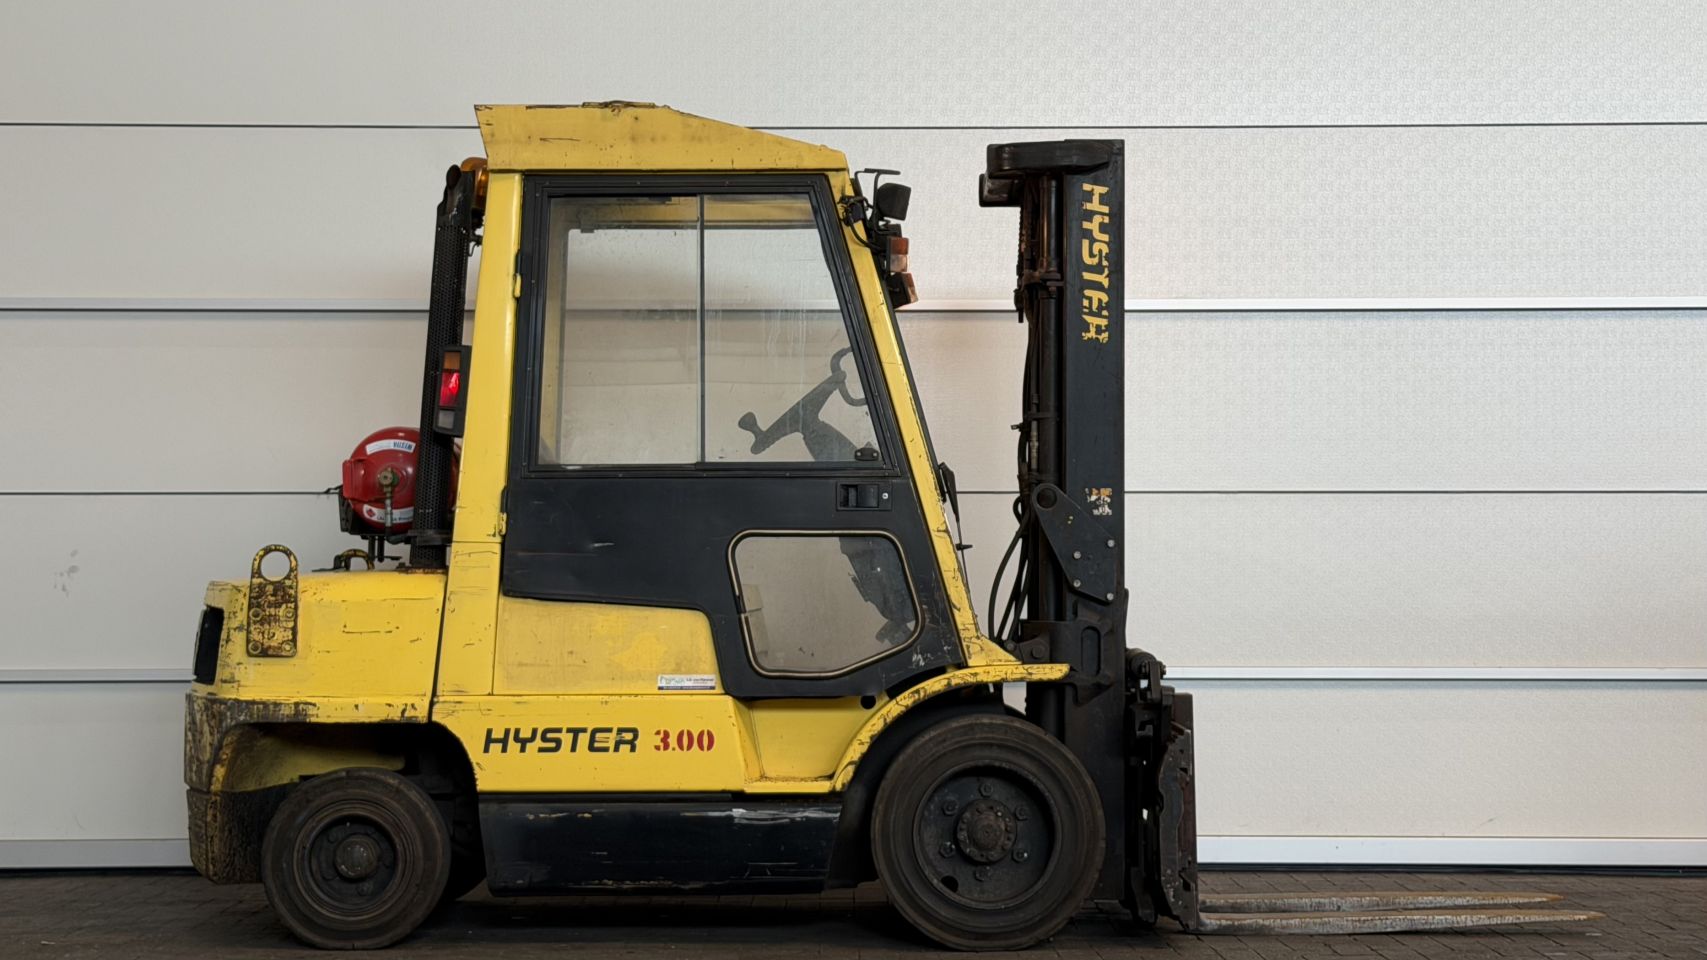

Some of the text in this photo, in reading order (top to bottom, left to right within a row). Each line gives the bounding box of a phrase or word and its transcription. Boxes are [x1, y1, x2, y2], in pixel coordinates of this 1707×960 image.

[1082, 183, 1110, 343] HYSTER
[483, 727, 715, 753] HYSTER 3.00
